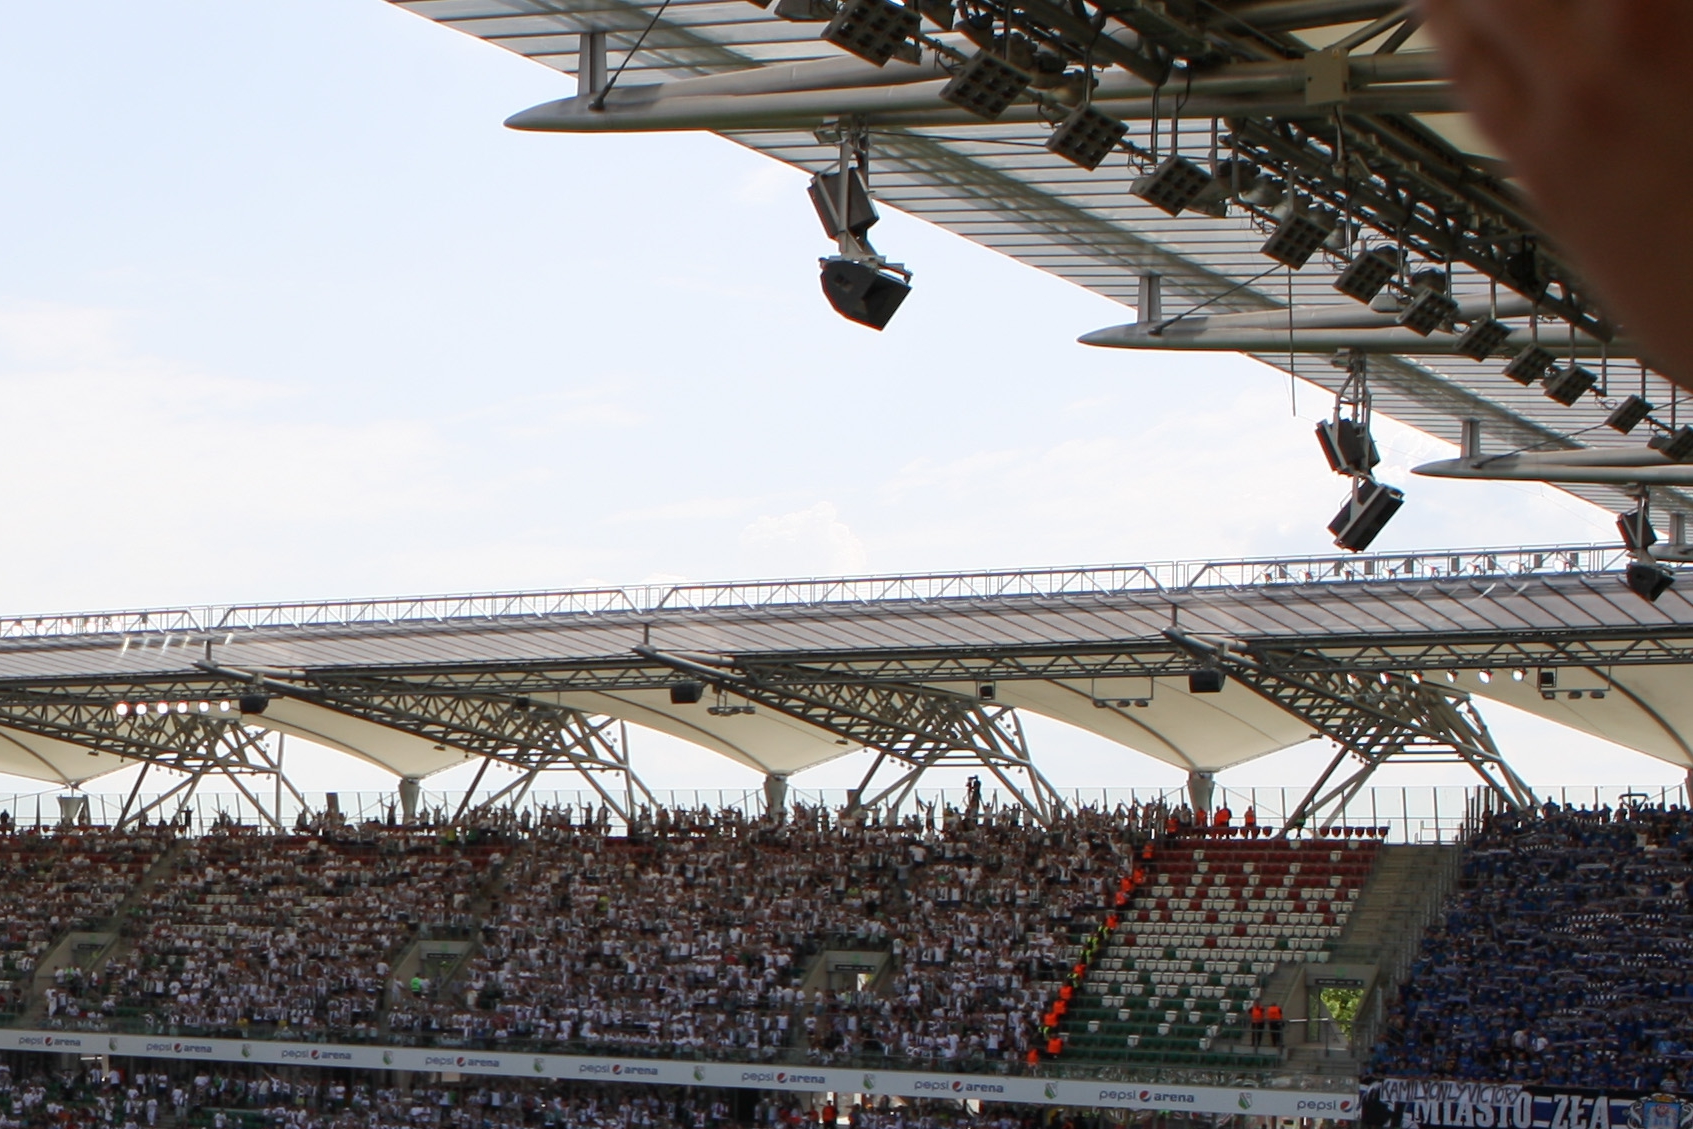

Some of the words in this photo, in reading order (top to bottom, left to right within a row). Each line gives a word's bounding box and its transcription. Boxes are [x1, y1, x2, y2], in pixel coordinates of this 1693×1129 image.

[426, 1057, 456, 1067] pepsi
[468, 1059, 499, 1068] arena
[579, 1065, 612, 1075] pepsi
[623, 1067, 658, 1076] arena
[742, 1073, 776, 1083] pepsi
[789, 1075, 825, 1084] arena
[915, 1081, 952, 1091] pepsi
[966, 1084, 1003, 1094] arena
[1099, 1091, 1138, 1102] pepsi
[1153, 1093, 1194, 1104] arena
[1297, 1101, 1339, 1112] pepsi
